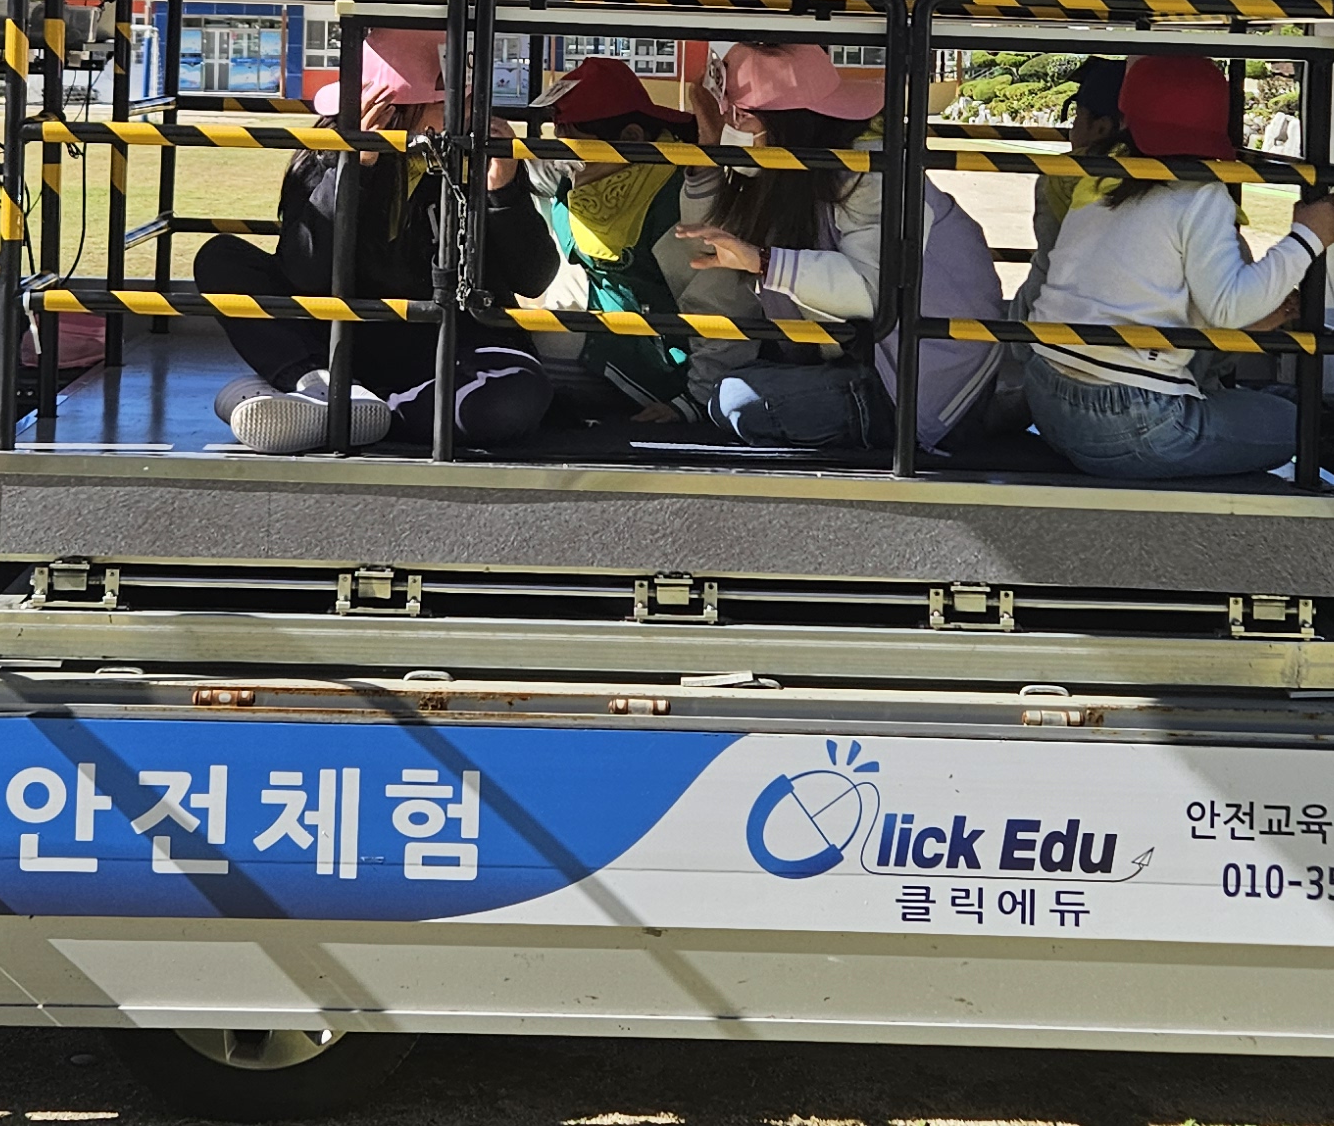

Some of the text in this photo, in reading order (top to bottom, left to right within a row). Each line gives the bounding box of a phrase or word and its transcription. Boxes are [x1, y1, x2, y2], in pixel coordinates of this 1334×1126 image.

[5, 762, 480, 880] 안전체험
[1186, 800, 1333, 844] 안전교육
[999, 819, 1118, 873] Edu
[895, 885, 1090, 927] 클릭에듀
